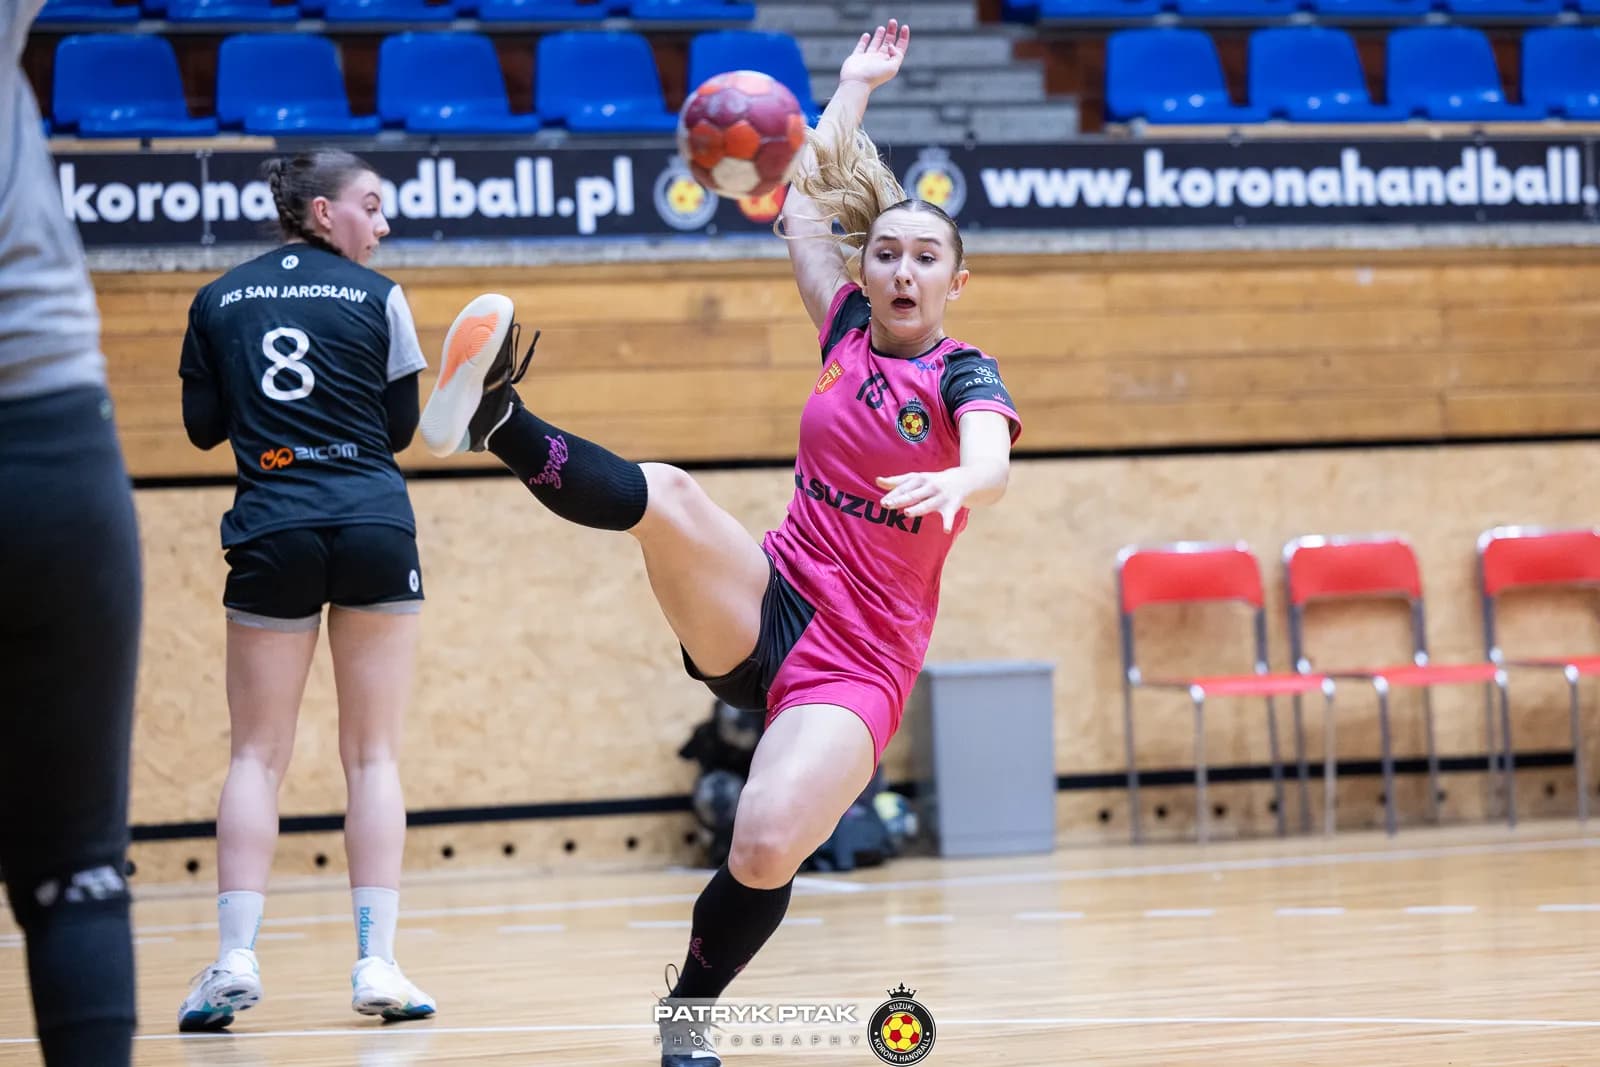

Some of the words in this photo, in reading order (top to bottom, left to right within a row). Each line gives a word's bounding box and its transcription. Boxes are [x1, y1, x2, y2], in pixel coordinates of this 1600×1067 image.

[980, 147, 1598, 207] www.koronahandball.
[220, 289, 242, 307] JKS
[245, 286, 278, 299] SAN
[281, 285, 367, 303] JAROSŁAW
[261, 327, 315, 401] 8
[805, 477, 924, 535] SUZUKI
